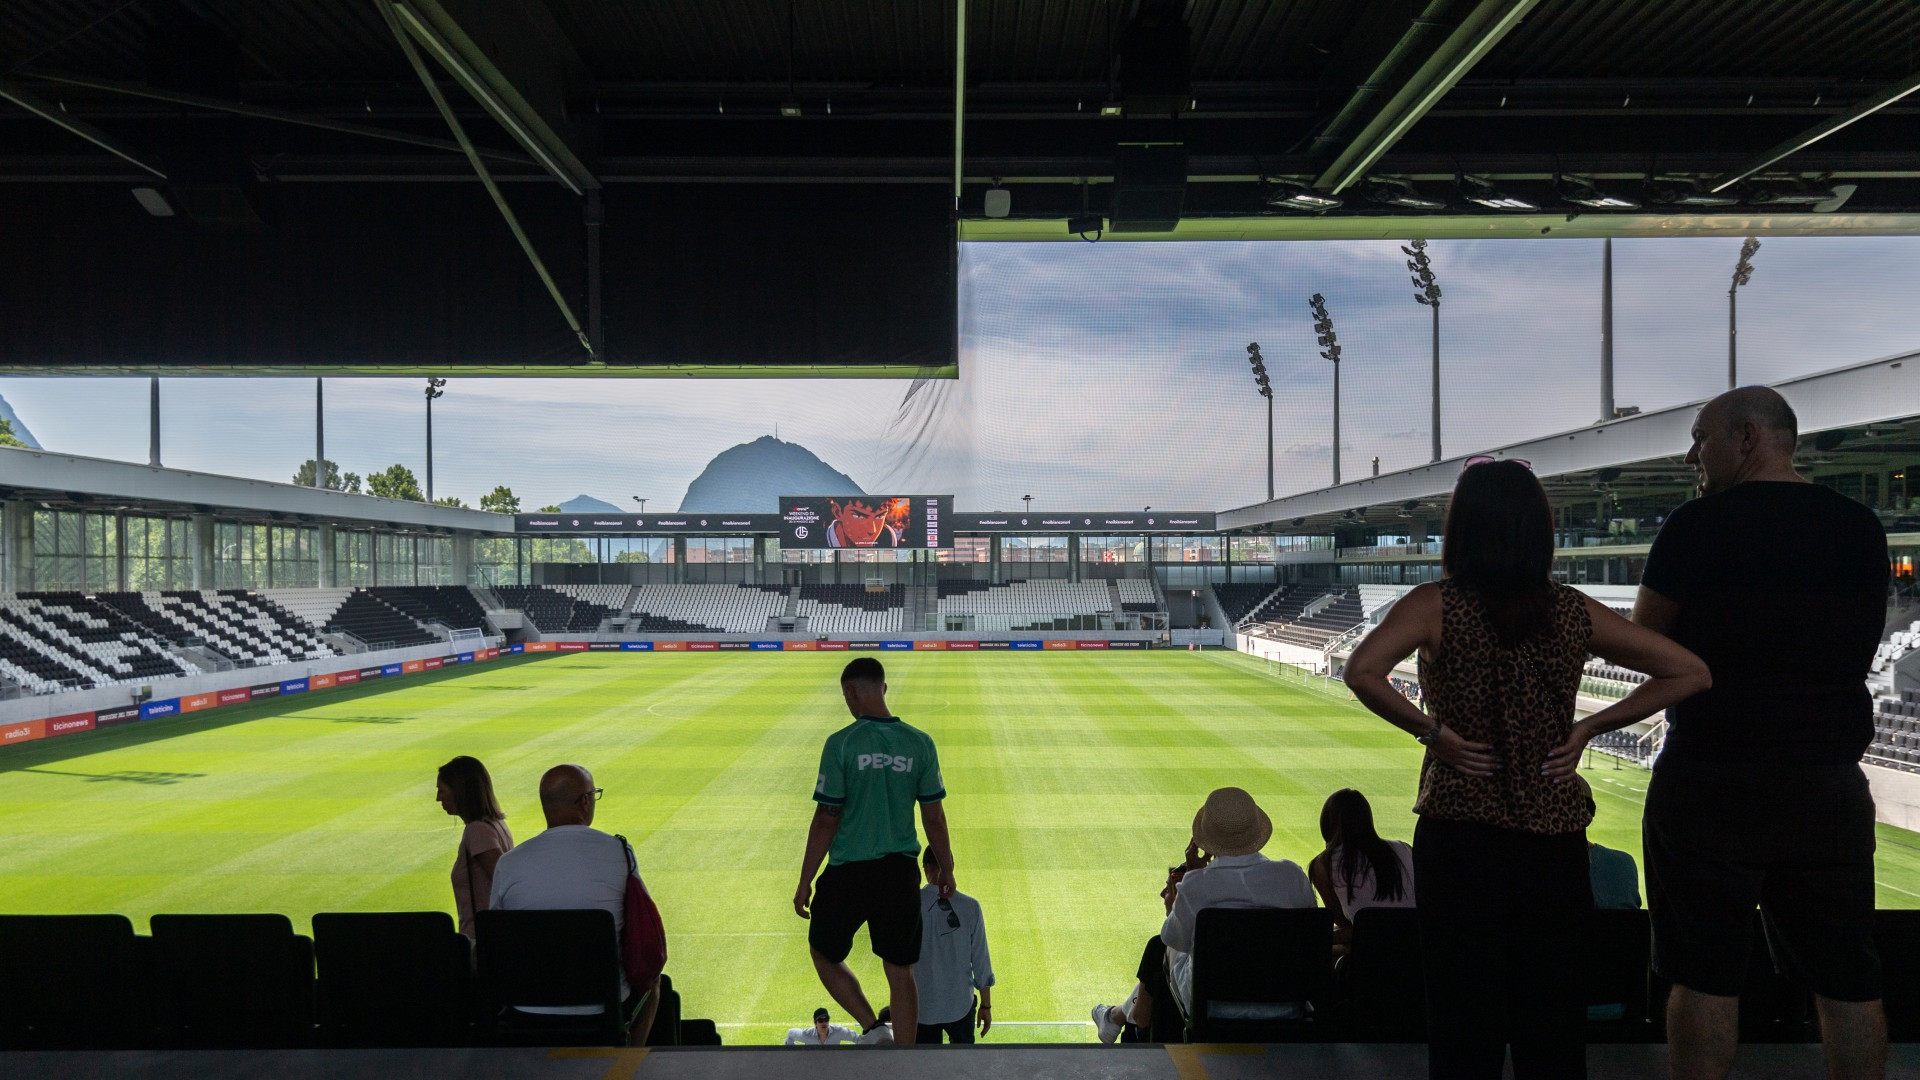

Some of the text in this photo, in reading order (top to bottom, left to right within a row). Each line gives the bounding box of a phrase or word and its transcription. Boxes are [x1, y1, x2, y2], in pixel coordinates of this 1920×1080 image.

[149, 704, 173, 714] teleticino
[53, 719, 88, 730] ticinonews
[5, 727, 30, 739] radio3i
[858, 753, 913, 772] PEPSI
